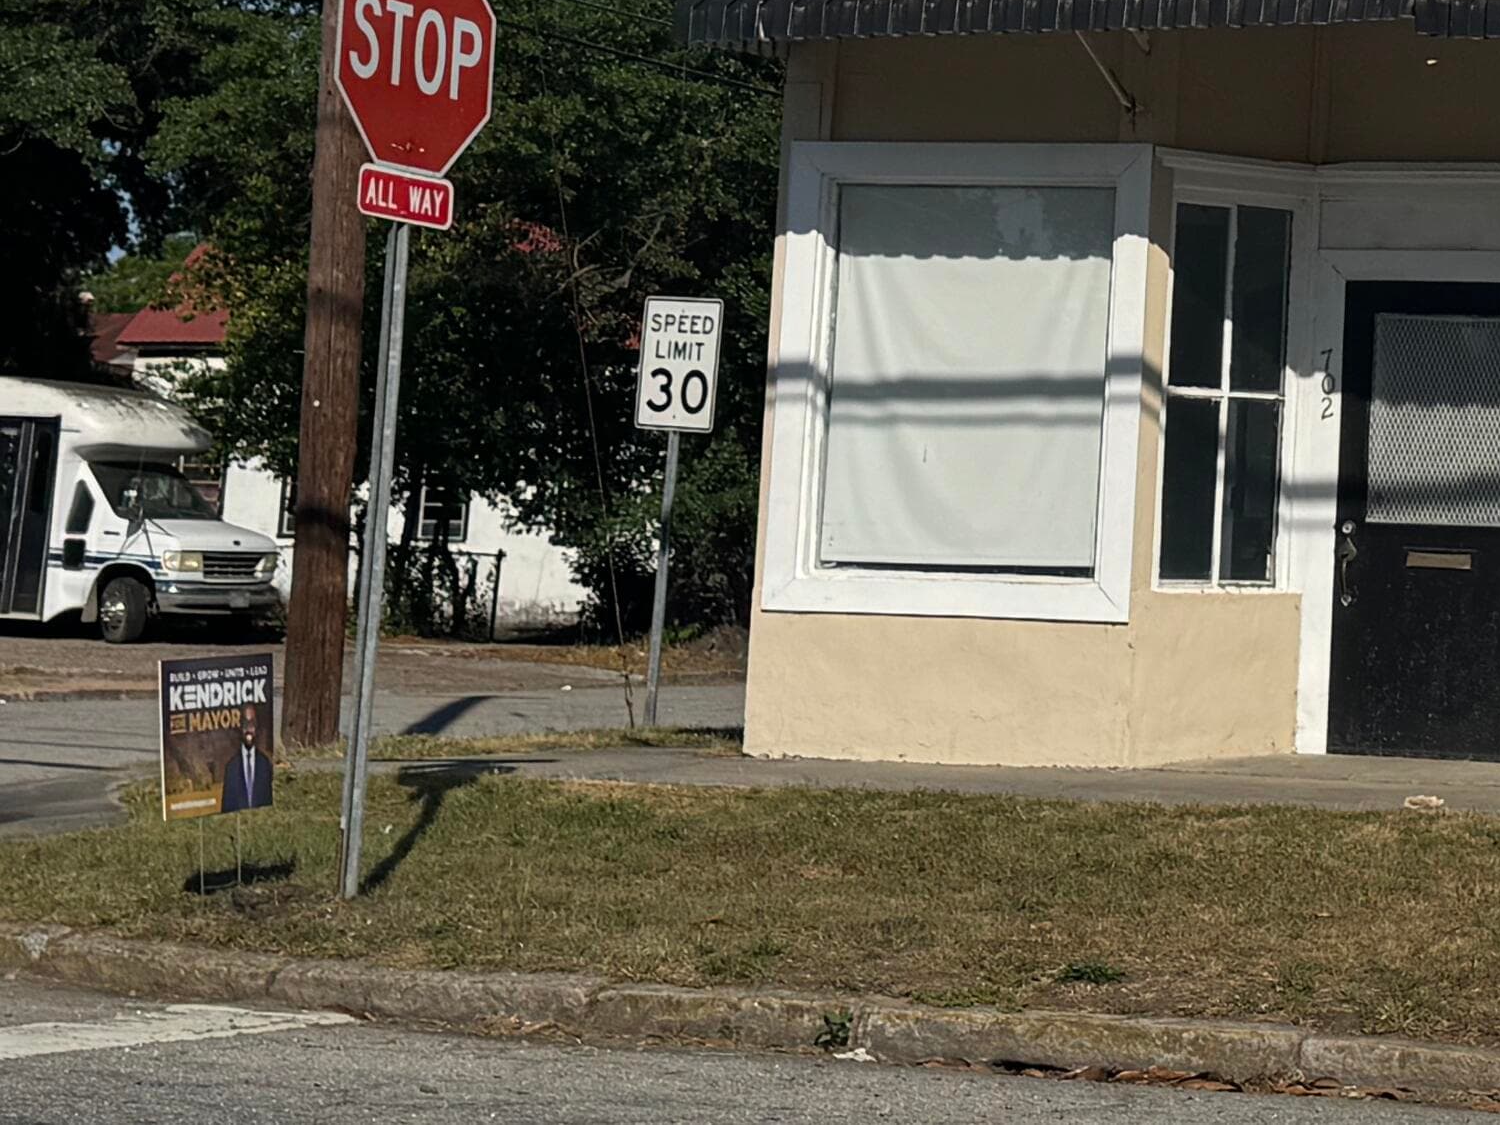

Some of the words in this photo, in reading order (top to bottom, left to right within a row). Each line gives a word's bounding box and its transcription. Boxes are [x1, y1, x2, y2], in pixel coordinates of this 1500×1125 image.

[365, 177, 397, 210] ALL
[408, 186, 445, 219] WAY
[651, 313, 714, 335] SPEED
[655, 340, 704, 361] LIMIT
[646, 368, 708, 414] 30
[1321, 348, 1335, 420] 702
[170, 679, 266, 711] KENDRICK
[189, 708, 241, 732] MAYOR
